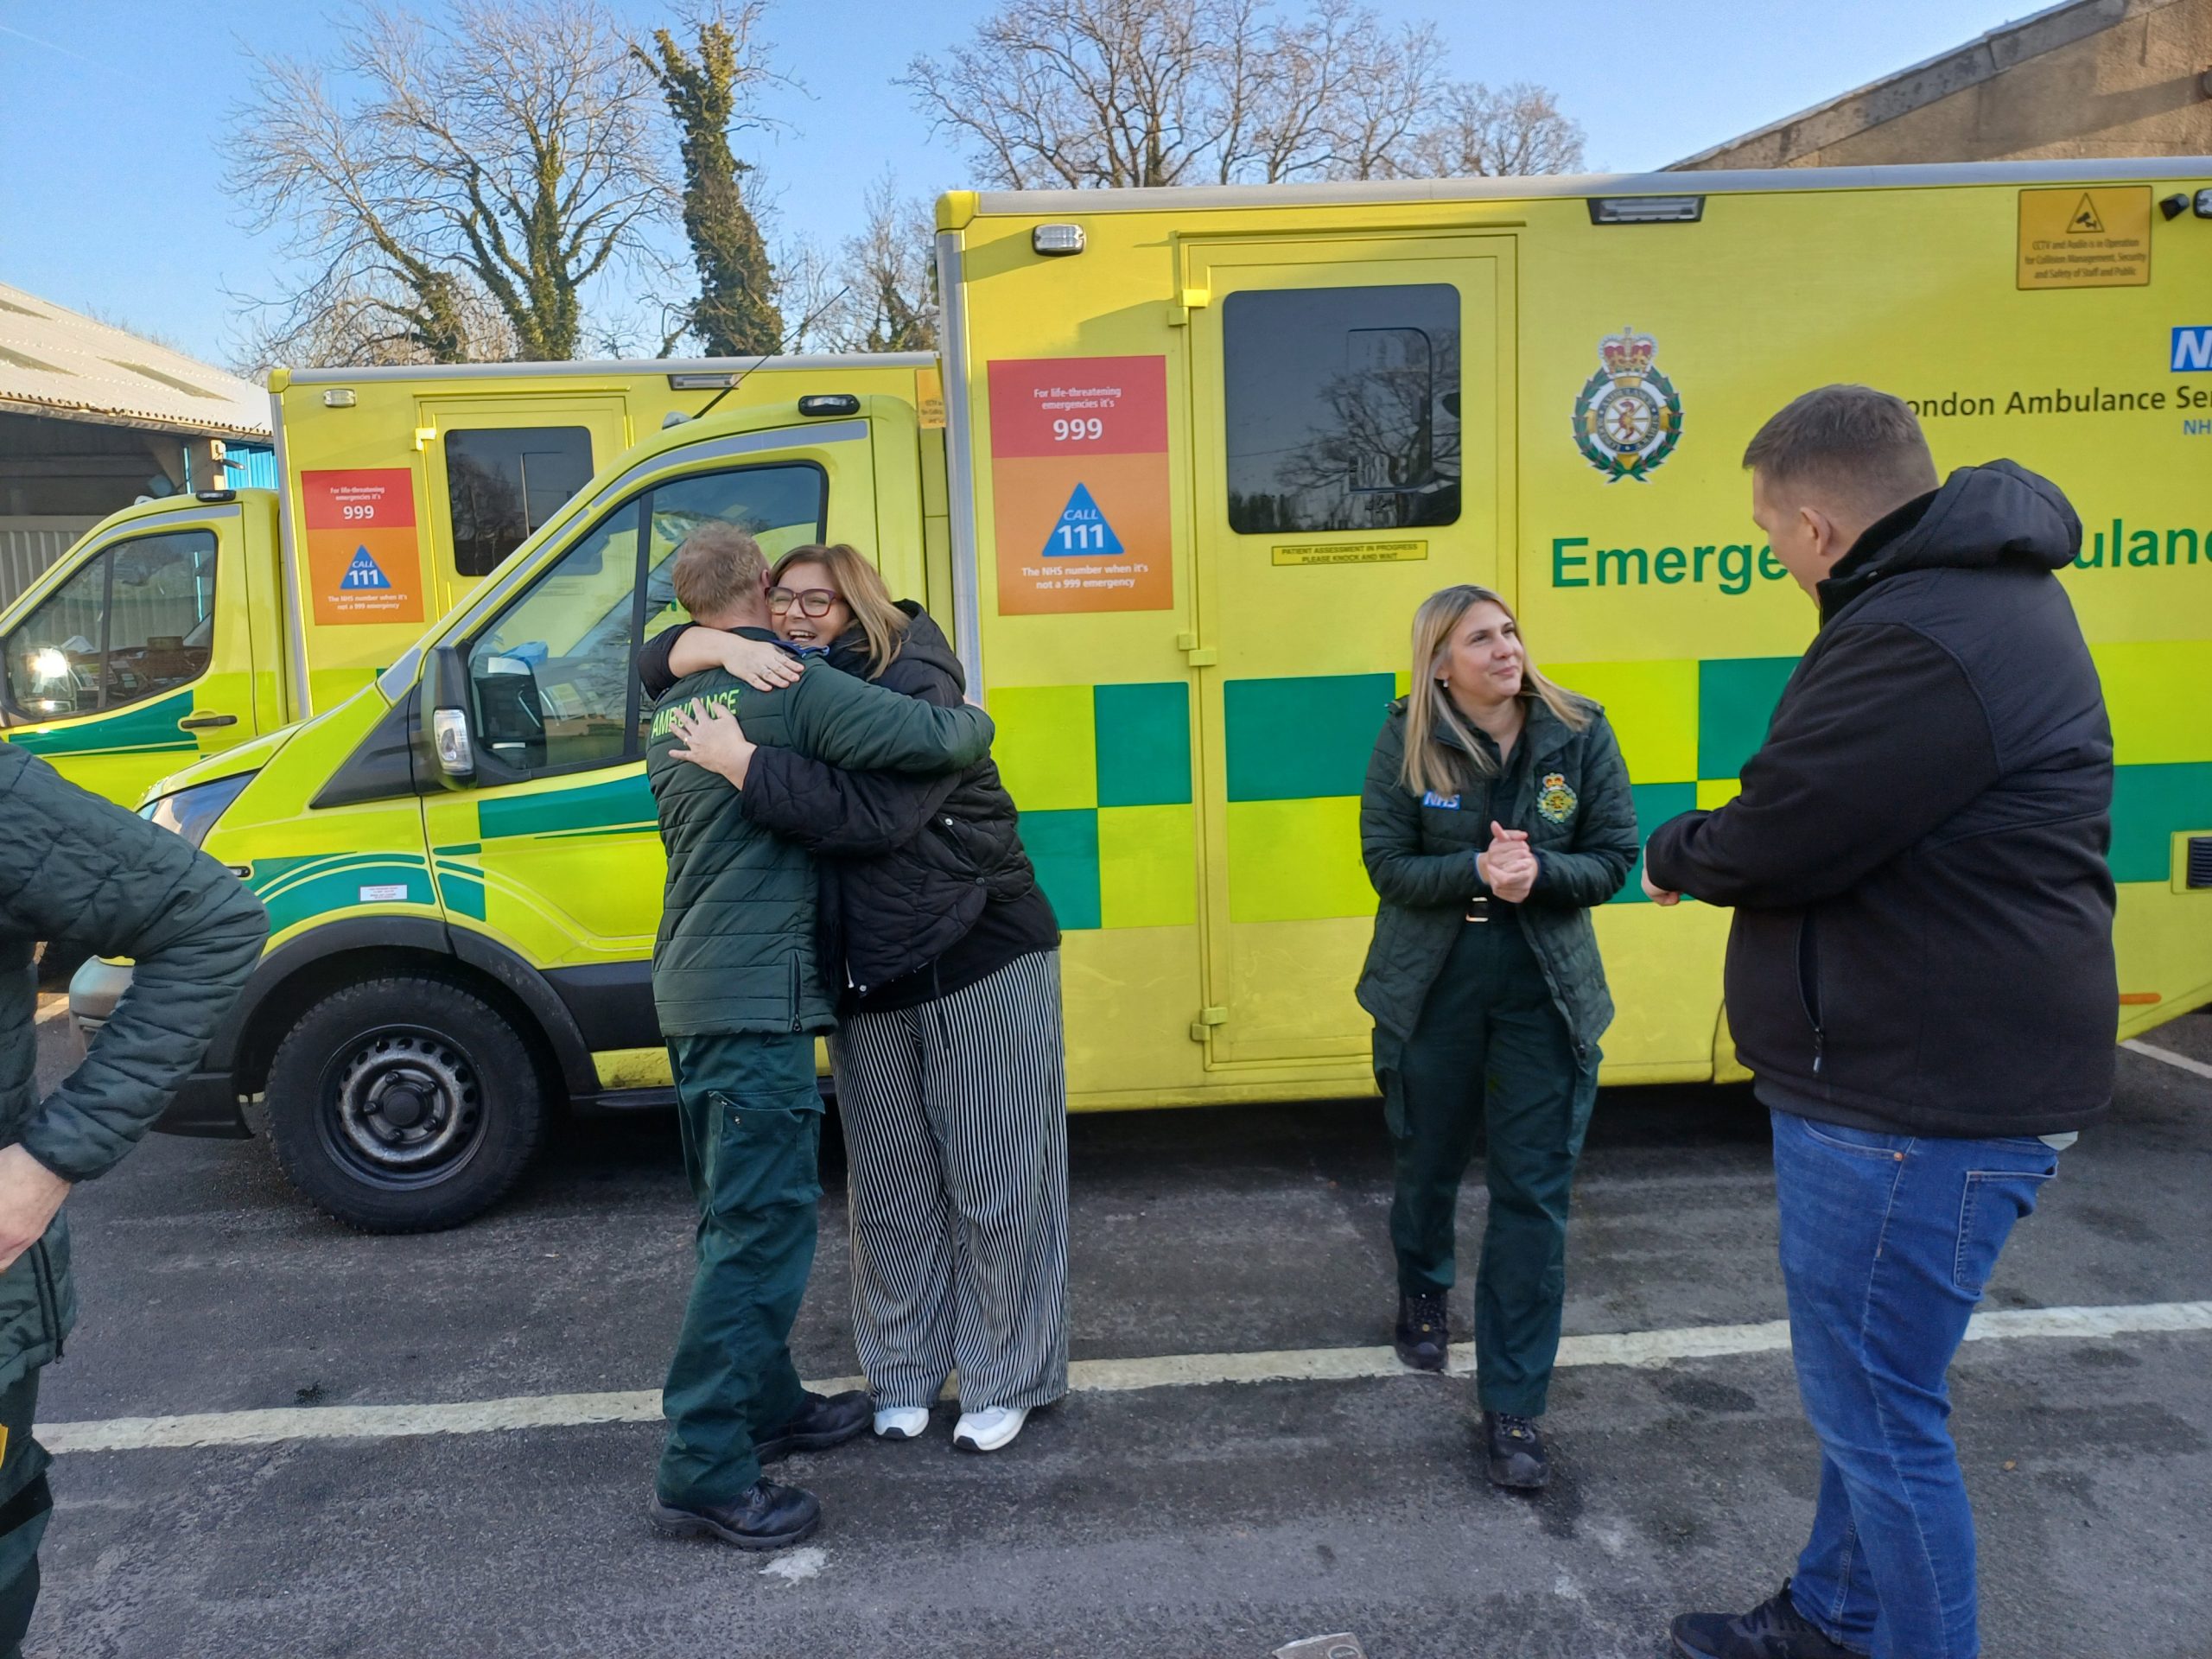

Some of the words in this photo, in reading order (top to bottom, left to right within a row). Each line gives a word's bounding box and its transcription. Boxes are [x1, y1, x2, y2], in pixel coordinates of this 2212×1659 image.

[2032, 240, 2051, 251] CCTV
[2173, 329, 2212, 369] N
[1033, 388, 1048, 397] For
[1051, 386, 1122, 397] life-threatening
[1041, 399, 1098, 411] emergencies
[1100, 398, 1115, 408] it's
[2004, 386, 2166, 416] Ambulance
[2176, 385, 2212, 410] Se
[1052, 417, 1103, 442] 999
[343, 505, 374, 520] 999
[1064, 508, 1099, 521] CALL
[1057, 523, 1103, 550] 111
[1314, 545, 1365, 554] ASSESSMENT
[1552, 537, 1789, 595] Emerge
[2074, 518, 2212, 569] ulan
[352, 560, 374, 569] CALL
[1021, 567, 1039, 576] The
[1042, 566, 1063, 576] NHS
[1065, 564, 1103, 575] number
[1104, 563, 1132, 574] when
[1134, 563, 1148, 572] it's
[349, 569, 379, 586] 111
[1036, 581, 1052, 589] not
[1064, 579, 1081, 588] 999
[1083, 578, 1135, 589] emergency
